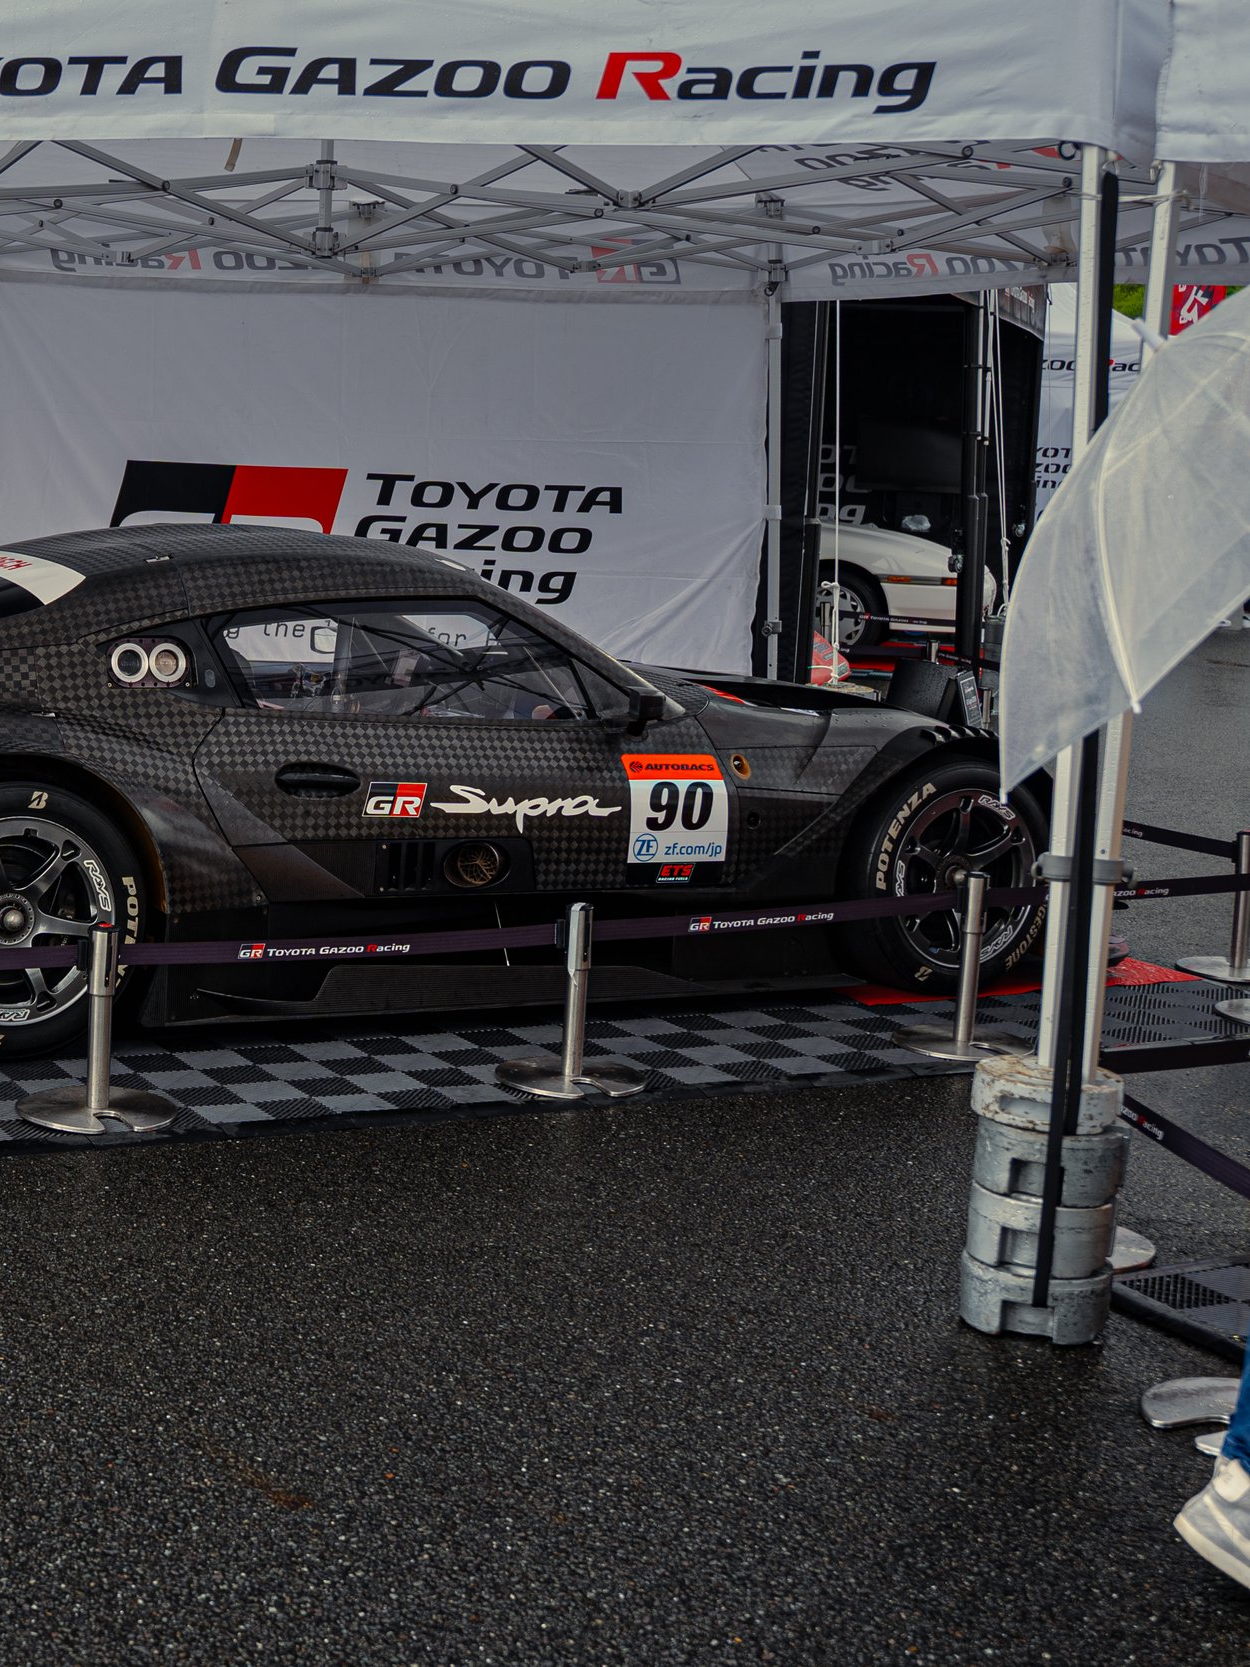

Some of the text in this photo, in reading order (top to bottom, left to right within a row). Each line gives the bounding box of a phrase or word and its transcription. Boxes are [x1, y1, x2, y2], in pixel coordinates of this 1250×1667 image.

[215, 47, 572, 99] GAZOO
[596, 51, 938, 114] Racing
[366, 473, 623, 514] TOYOTA
[354, 515, 593, 554] GAZOO
[645, 763, 715, 771] AUTOBACS
[365, 784, 622, 833] GR Supra
[646, 781, 714, 831] 90
[636, 839, 723, 858] ZF zf.com/jp
[875, 782, 937, 890] POTENZA
[83, 859, 112, 912] RAYS
[660, 864, 694, 877] ETS
[1137, 887, 1169, 896] Racing
[713, 919, 754, 929] TOYOTA
[757, 916, 795, 925] GAZOO
[797, 912, 834, 921] Racing
[267, 948, 316, 957] TOYOTA
[319, 946, 364, 955] GAZOO
[367, 943, 411, 953] Racing
